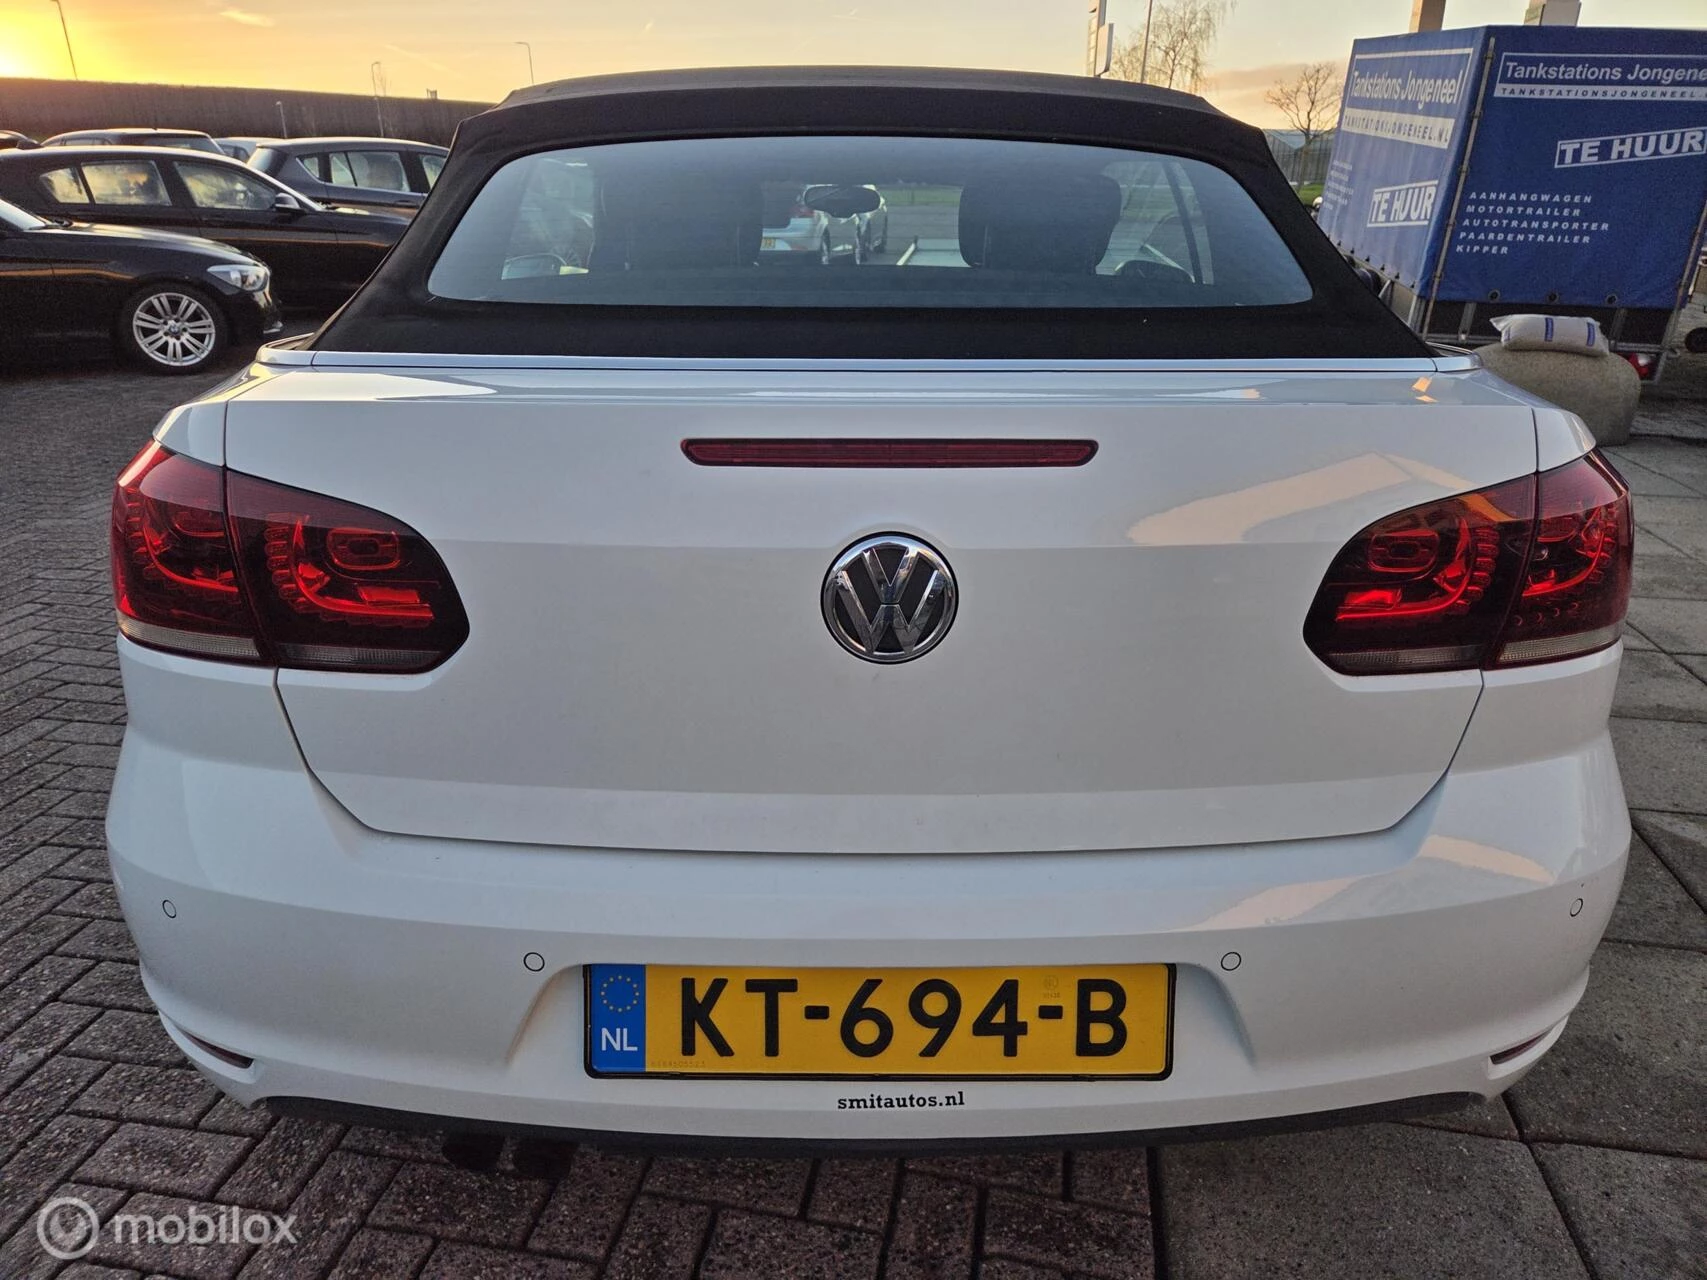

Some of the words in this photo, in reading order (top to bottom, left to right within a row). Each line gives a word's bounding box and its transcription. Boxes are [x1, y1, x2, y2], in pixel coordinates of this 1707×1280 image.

[1505, 62, 1622, 80] Tankstations
[1350, 70, 1403, 100] Tankstations
[1401, 69, 1464, 110] Jongeneel
[1501, 87, 1707, 98] TANKSTATIONSJONGENEEL.
[1560, 141, 1601, 164] TE
[1610, 130, 1705, 160] HUUR
[1371, 191, 1391, 222] TE
[1390, 185, 1437, 222] HUUR
[1469, 191, 1592, 203] AANHANGWAGEN
[1466, 204, 1581, 217] MOTORTRAILER
[1462, 218, 1609, 231] AUTOTRANSPORTER
[1459, 231, 1591, 244] PAARDENTRAILER
[1456, 244, 1508, 255] KIPPER
[600, 1027, 638, 1052] NL
[680, 977, 1129, 1058] KT-694-B
[837, 1090, 966, 1110] smitautos.nl
